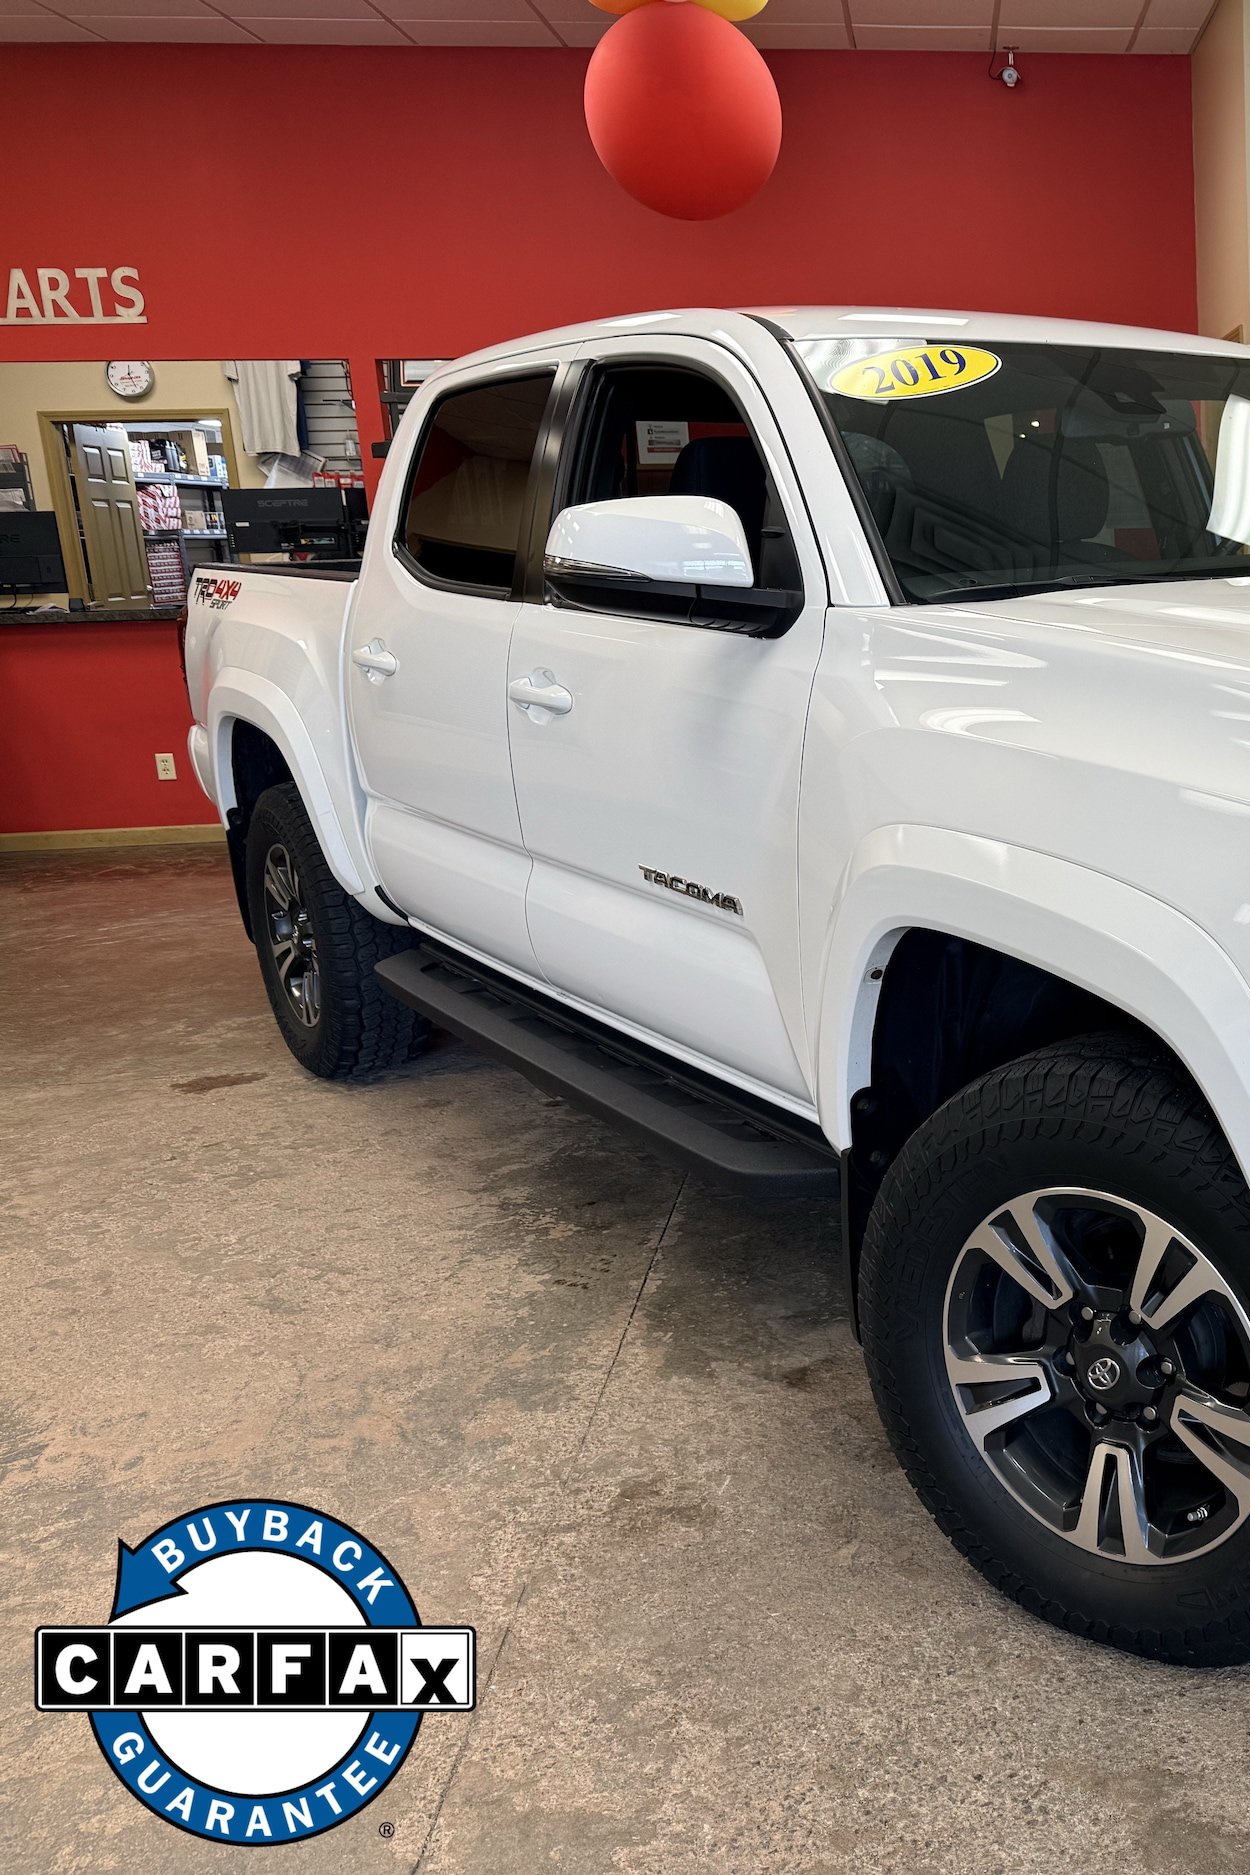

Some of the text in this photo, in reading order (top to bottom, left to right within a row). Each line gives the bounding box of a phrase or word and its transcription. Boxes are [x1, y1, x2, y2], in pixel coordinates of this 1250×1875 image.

[6, 266, 145, 319] ARTS
[862, 349, 967, 394] 2019
[256, 499, 309, 508] SCEPTRE
[209, 598, 233, 610] SPORT
[638, 863, 744, 917] TACOMA
